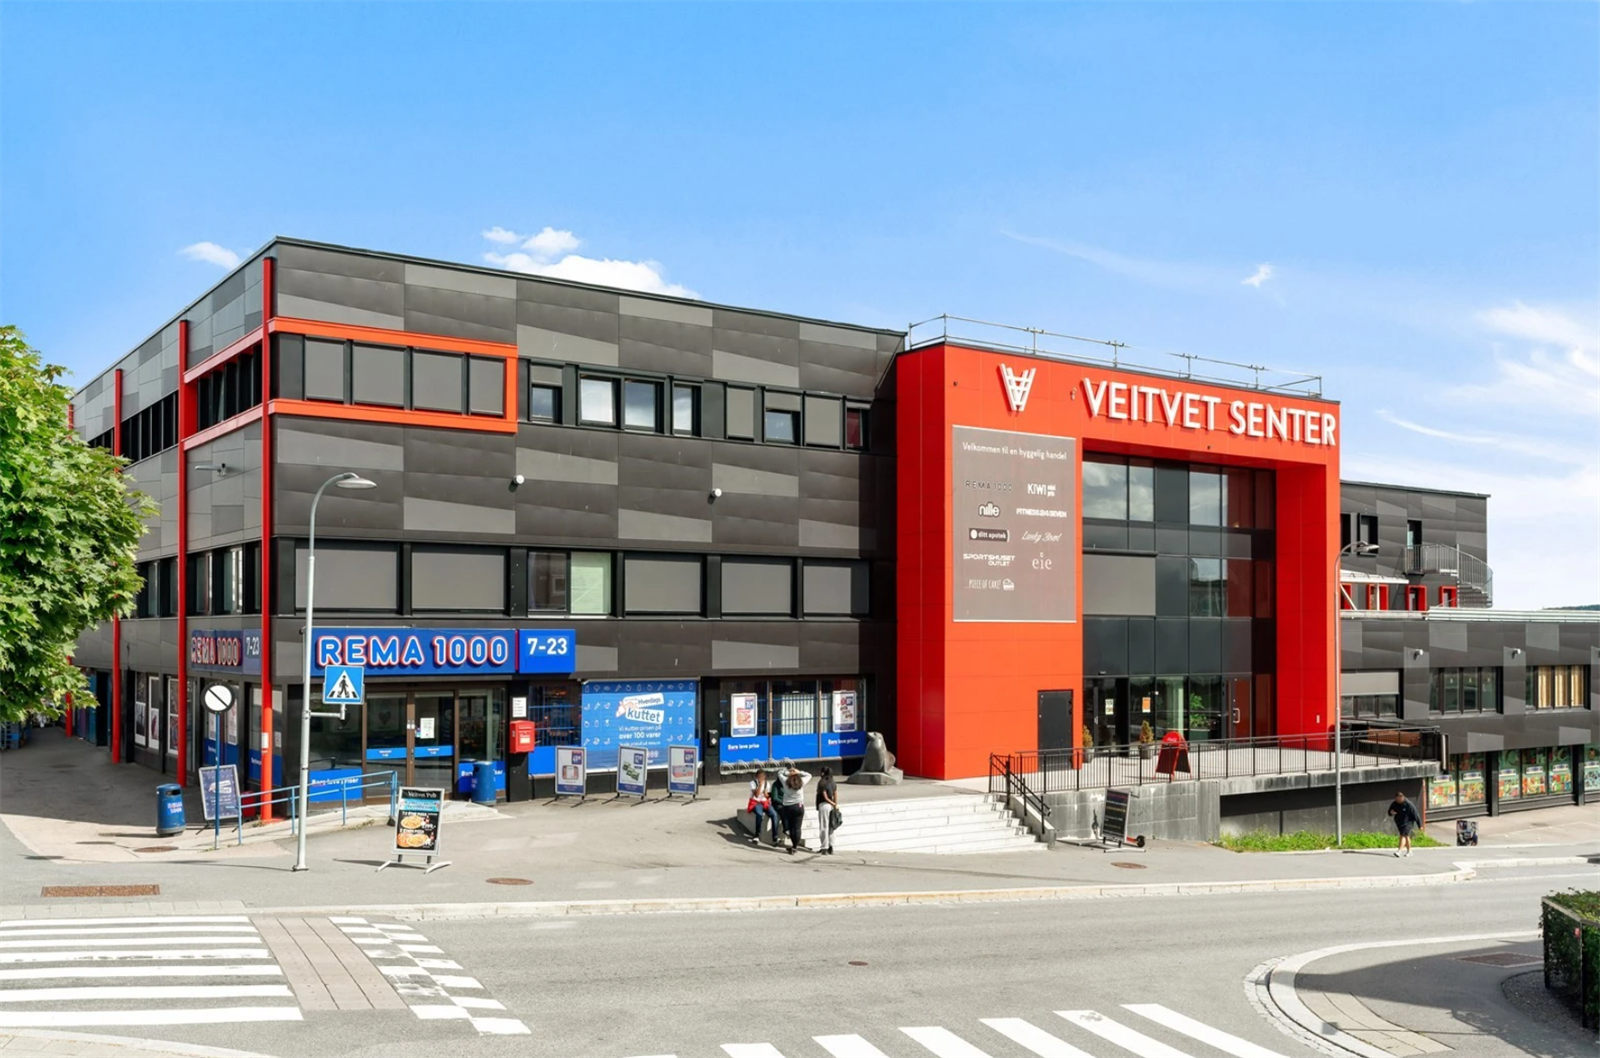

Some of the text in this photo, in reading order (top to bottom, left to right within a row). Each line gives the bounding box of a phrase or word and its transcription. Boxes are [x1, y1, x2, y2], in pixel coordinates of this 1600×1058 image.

[1080, 377, 1337, 447] VEITVET SENTER
[962, 442, 1001, 454] Velkommen
[1009, 448, 1018, 456] en
[1019, 447, 1045, 460] hyggelig
[1046, 450, 1067, 460] handel
[966, 480, 1012, 492] REMA 1000
[1027, 483, 1047, 496] KIWI
[979, 502, 1000, 517] nille
[989, 532, 1007, 540] apotek
[963, 553, 1015, 562] SPORTSHUSET
[1032, 551, 1052, 570] eie
[217, 637, 240, 667] 1000
[246, 636, 260, 656] 7-23
[317, 635, 509, 667] REMA 1000
[527, 637, 568, 656] 7-23
[627, 708, 662, 723] kuttet
[655, 723, 662, 731] på
[633, 731, 645, 739] 100
